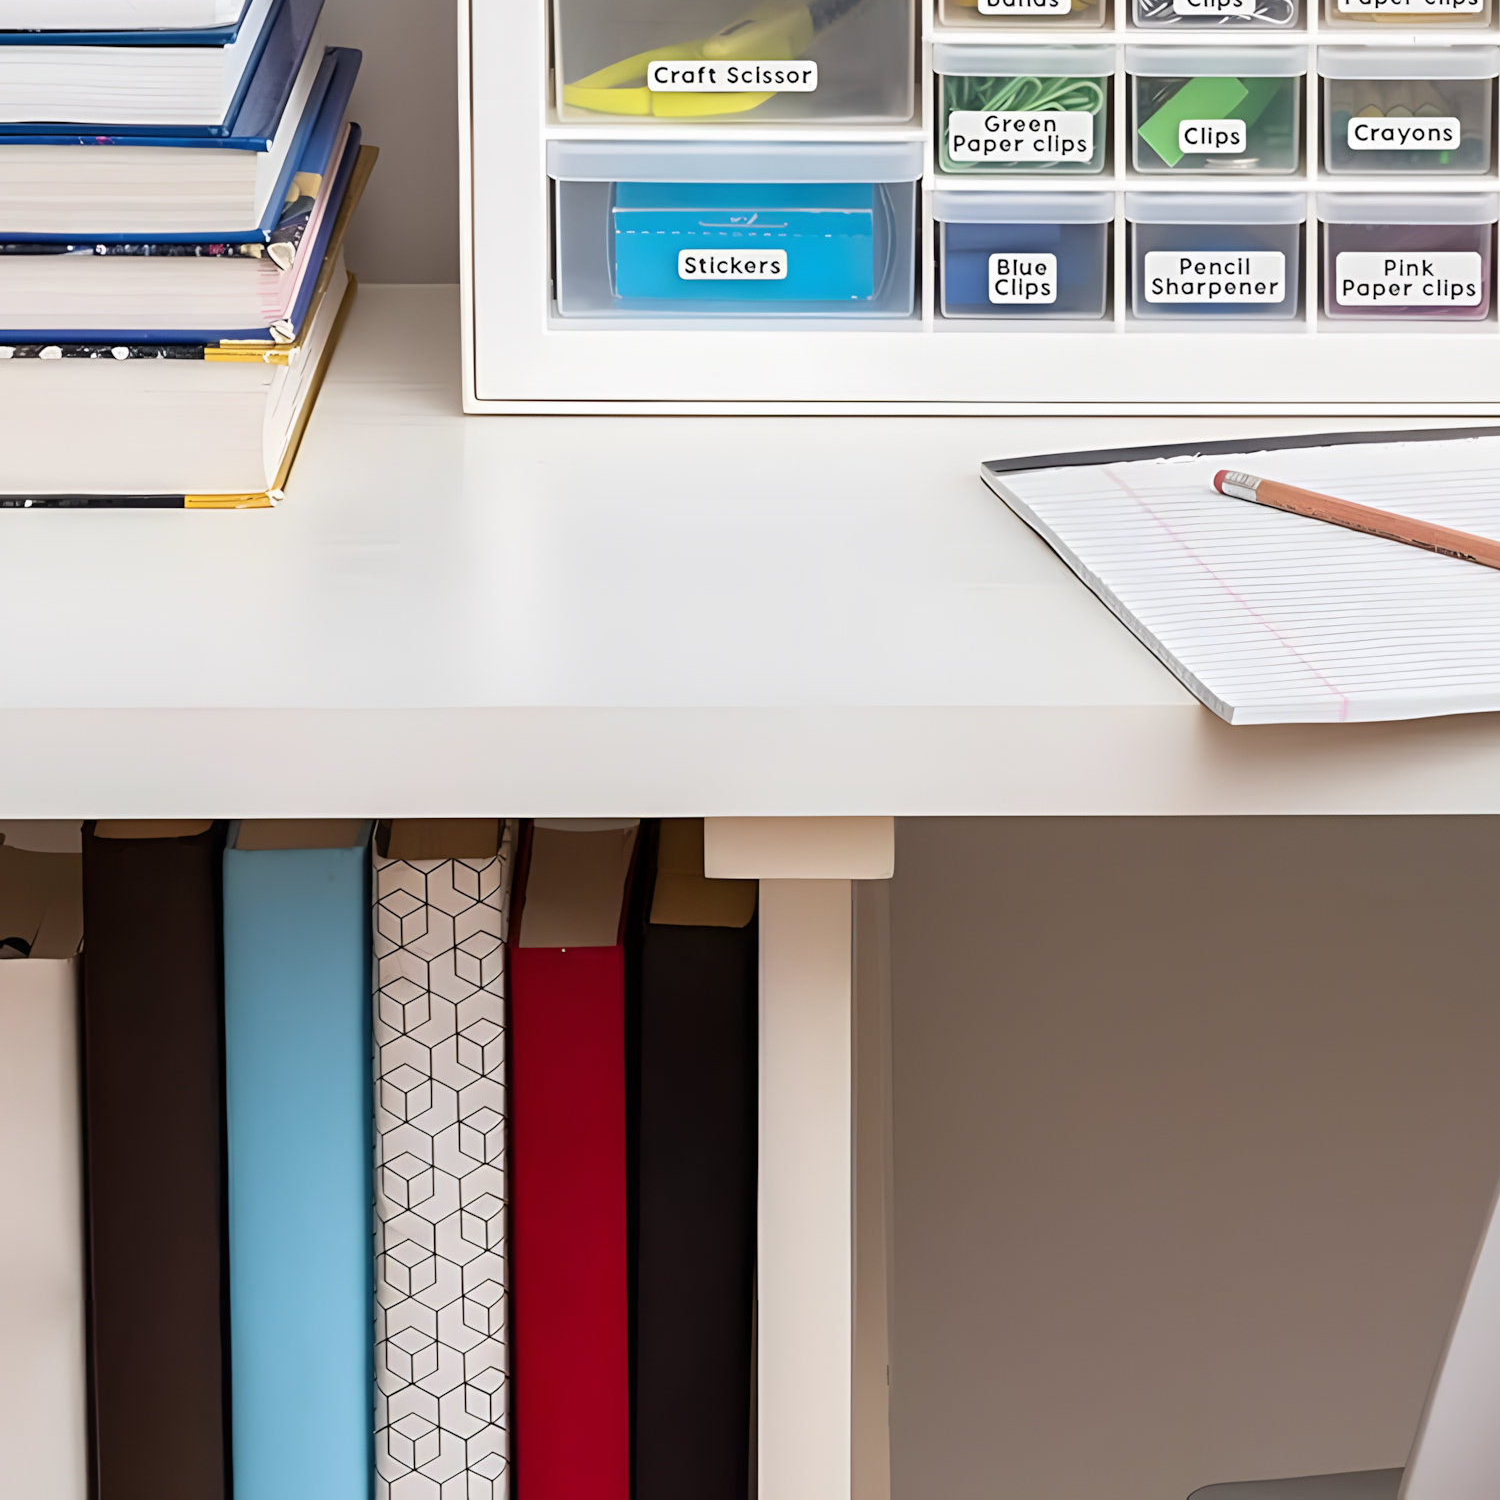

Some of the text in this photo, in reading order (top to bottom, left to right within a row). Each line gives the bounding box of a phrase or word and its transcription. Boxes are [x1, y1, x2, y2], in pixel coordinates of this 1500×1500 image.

[654, 66, 812, 84] Craft Scissor
[984, 115, 1056, 133] Green
[953, 134, 1087, 156] Paper clips
[1184, 127, 1240, 149] Clips
[1354, 124, 1453, 146] Crayons
[684, 256, 781, 275] Stickers
[997, 258, 1047, 276] Blue
[1180, 257, 1250, 275] Pencil
[1384, 259, 1434, 277] Pink
[994, 278, 1051, 300] Clips
[1151, 277, 1279, 299] Sharpener
[1343, 279, 1476, 300] Paper clips
